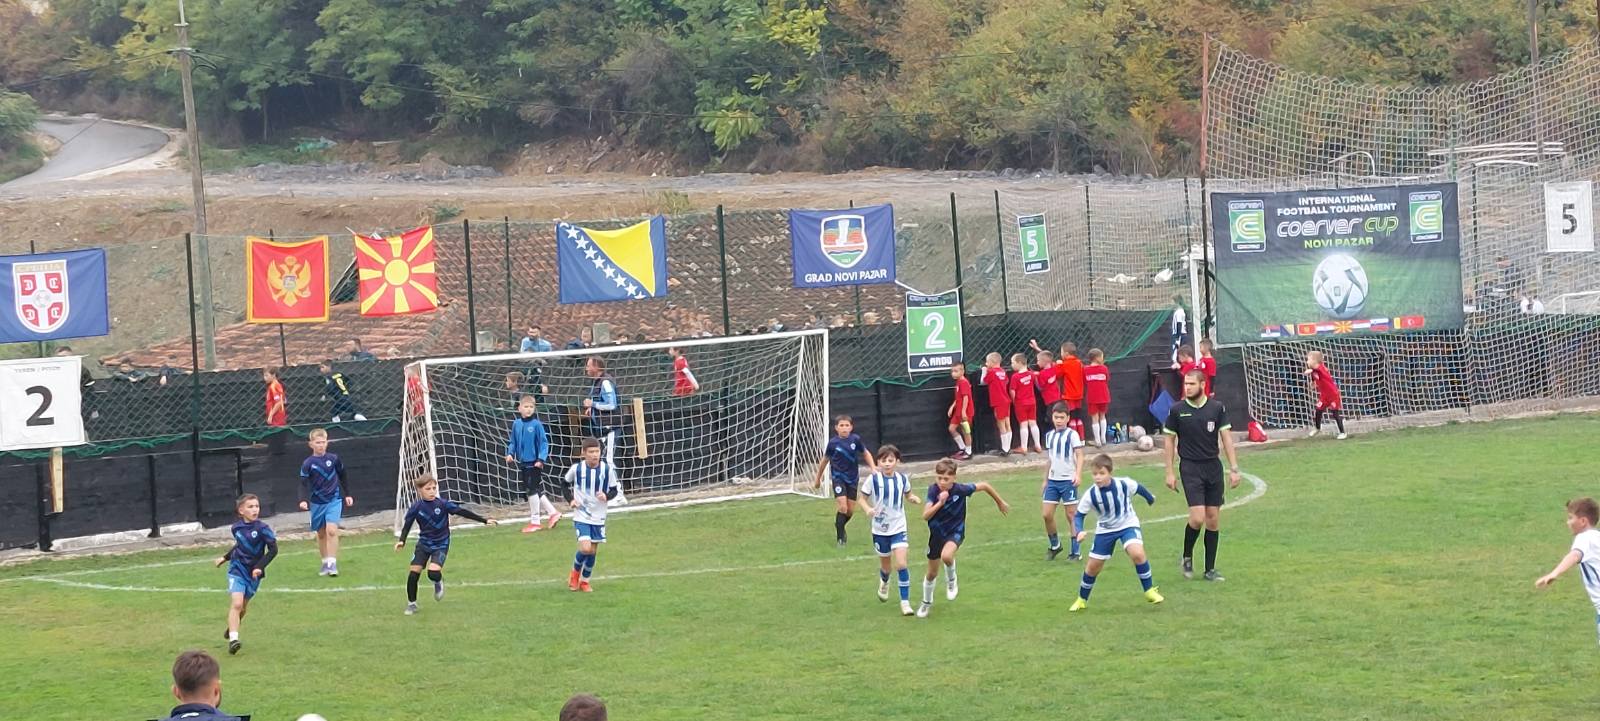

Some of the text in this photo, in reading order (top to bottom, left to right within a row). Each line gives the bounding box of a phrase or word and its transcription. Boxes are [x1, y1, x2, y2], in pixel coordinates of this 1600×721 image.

[1277, 203, 1397, 216] FOOTBALL TOURNAMENT
[1298, 194, 1376, 206] INTERNATIONAL
[1562, 203, 1578, 235] 5
[1026, 229, 1039, 258] 5
[1304, 237, 1374, 248] NOVI PAZAR
[804, 268, 887, 283] GRAD NOVI PAZAR
[923, 311, 946, 350] 2
[25, 385, 55, 427] 2
